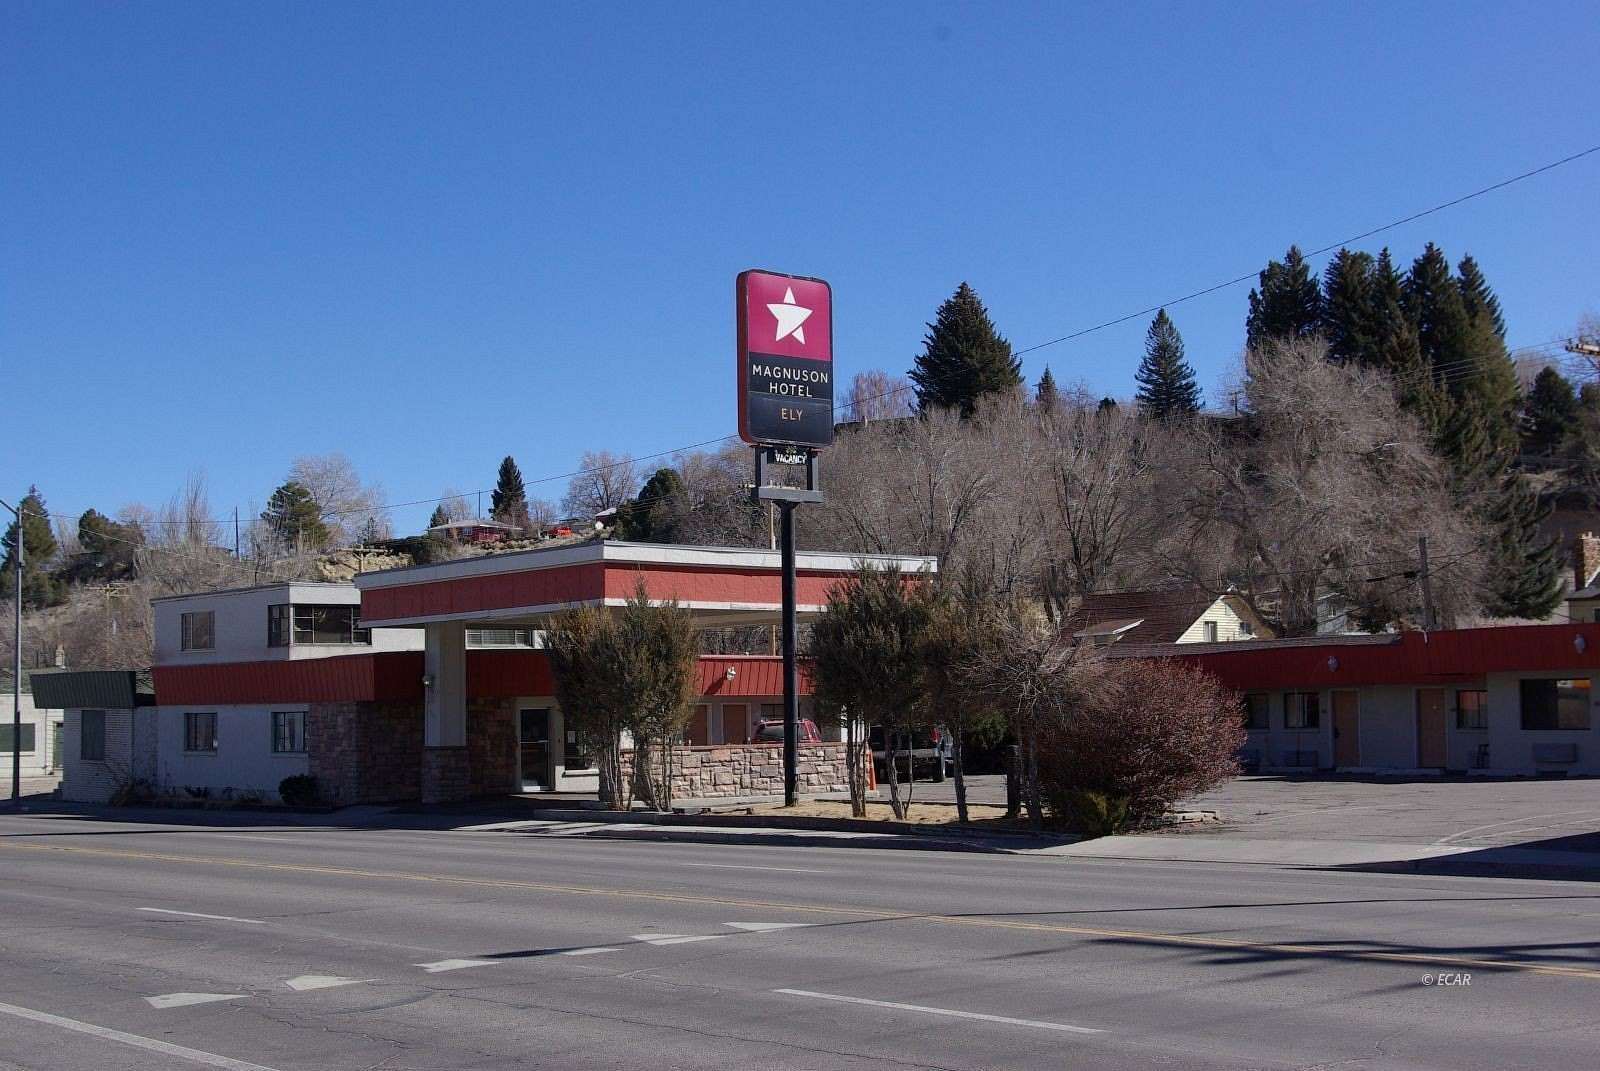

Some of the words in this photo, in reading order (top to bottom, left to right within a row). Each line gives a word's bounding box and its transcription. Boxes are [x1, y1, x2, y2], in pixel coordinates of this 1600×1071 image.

[752, 364, 828, 383] MAGNUSON
[769, 382, 813, 397] HOTEL
[781, 408, 803, 421] ELY
[775, 451, 807, 464] VACANCY
